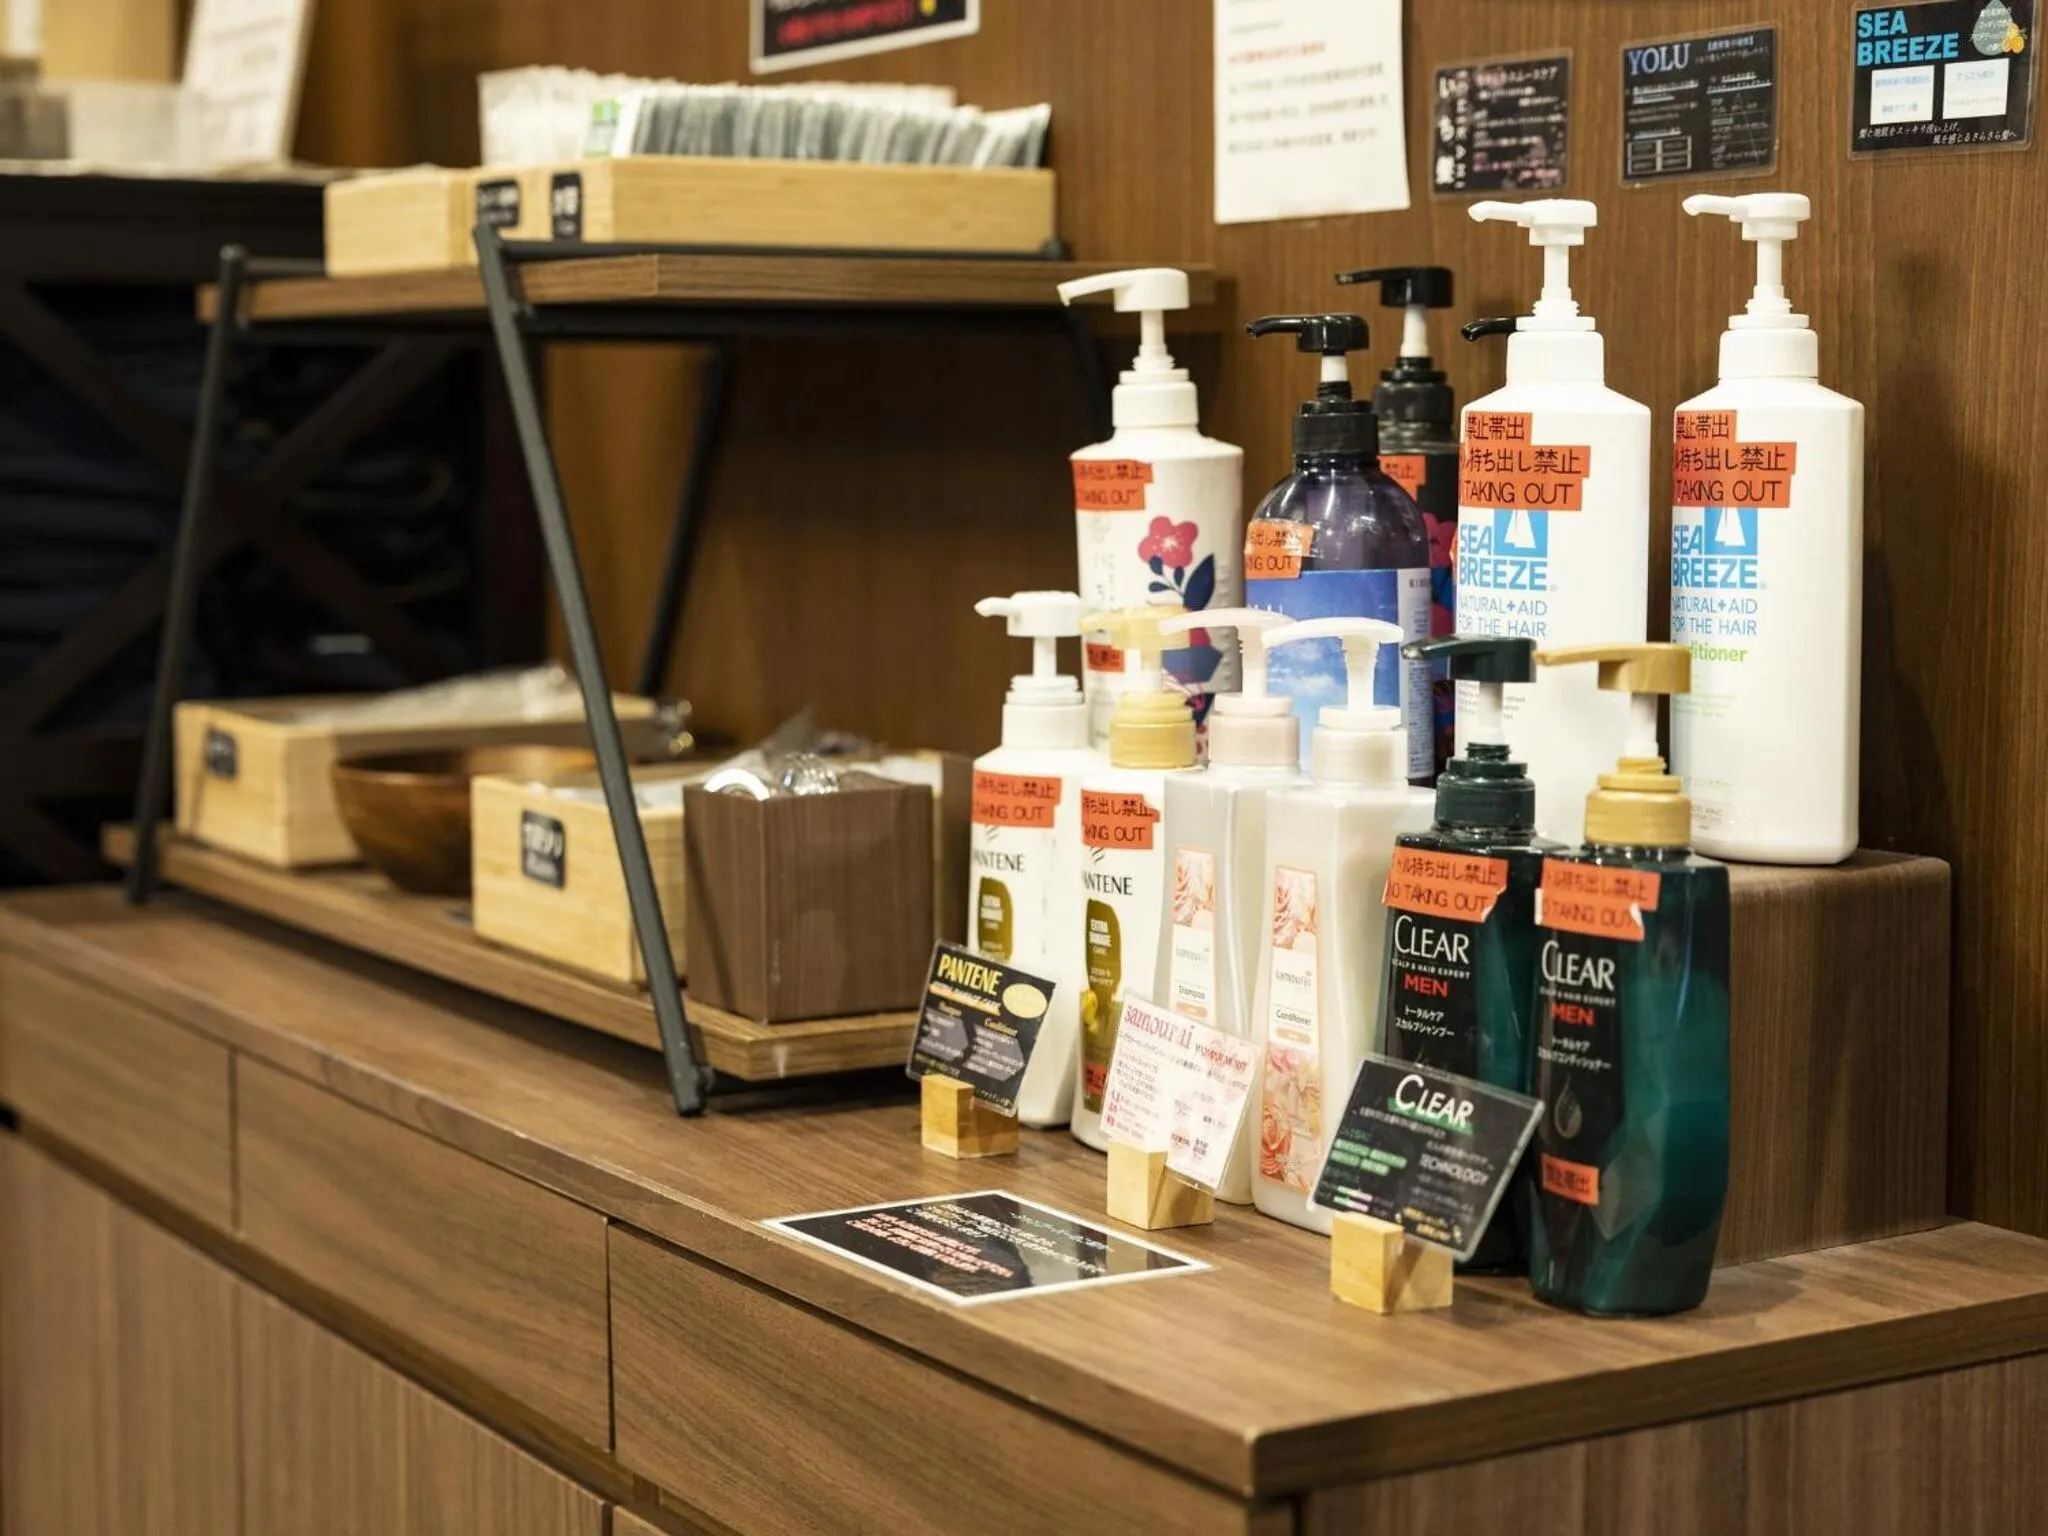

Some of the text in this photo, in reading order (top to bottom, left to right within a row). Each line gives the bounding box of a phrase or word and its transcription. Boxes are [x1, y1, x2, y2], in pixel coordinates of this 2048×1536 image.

[1857, 11, 1908, 38] SEA
[1628, 43, 1691, 76] YOLU
[1857, 32, 1959, 67] BREEZE
[1524, 482, 1574, 504] OUT
[1732, 480, 1783, 502] OUT
[1460, 524, 1493, 555] SEA
[1673, 525, 1703, 555] SEA
[1267, 555, 1292, 571] OUT
[1459, 556, 1548, 591] BREEZE
[1672, 557, 1758, 589] BREEZE
[1478, 617, 1501, 635] THE
[1508, 620, 1546, 638] HAIR
[1690, 618, 1712, 634] THE
[1718, 619, 1757, 636] HAIR
[1013, 805, 1046, 821] OUT
[1114, 826, 1146, 842] OUT
[1454, 892, 1489, 913] OUT
[1394, 915, 1470, 965] CLEAR
[937, 953, 1003, 996] PANTENE
[1541, 940, 1615, 992] CLEAR
[1404, 973, 1448, 998] MEN
[1551, 1002, 1594, 1026] MEN
[1395, 1074, 1474, 1130] CLEAR
